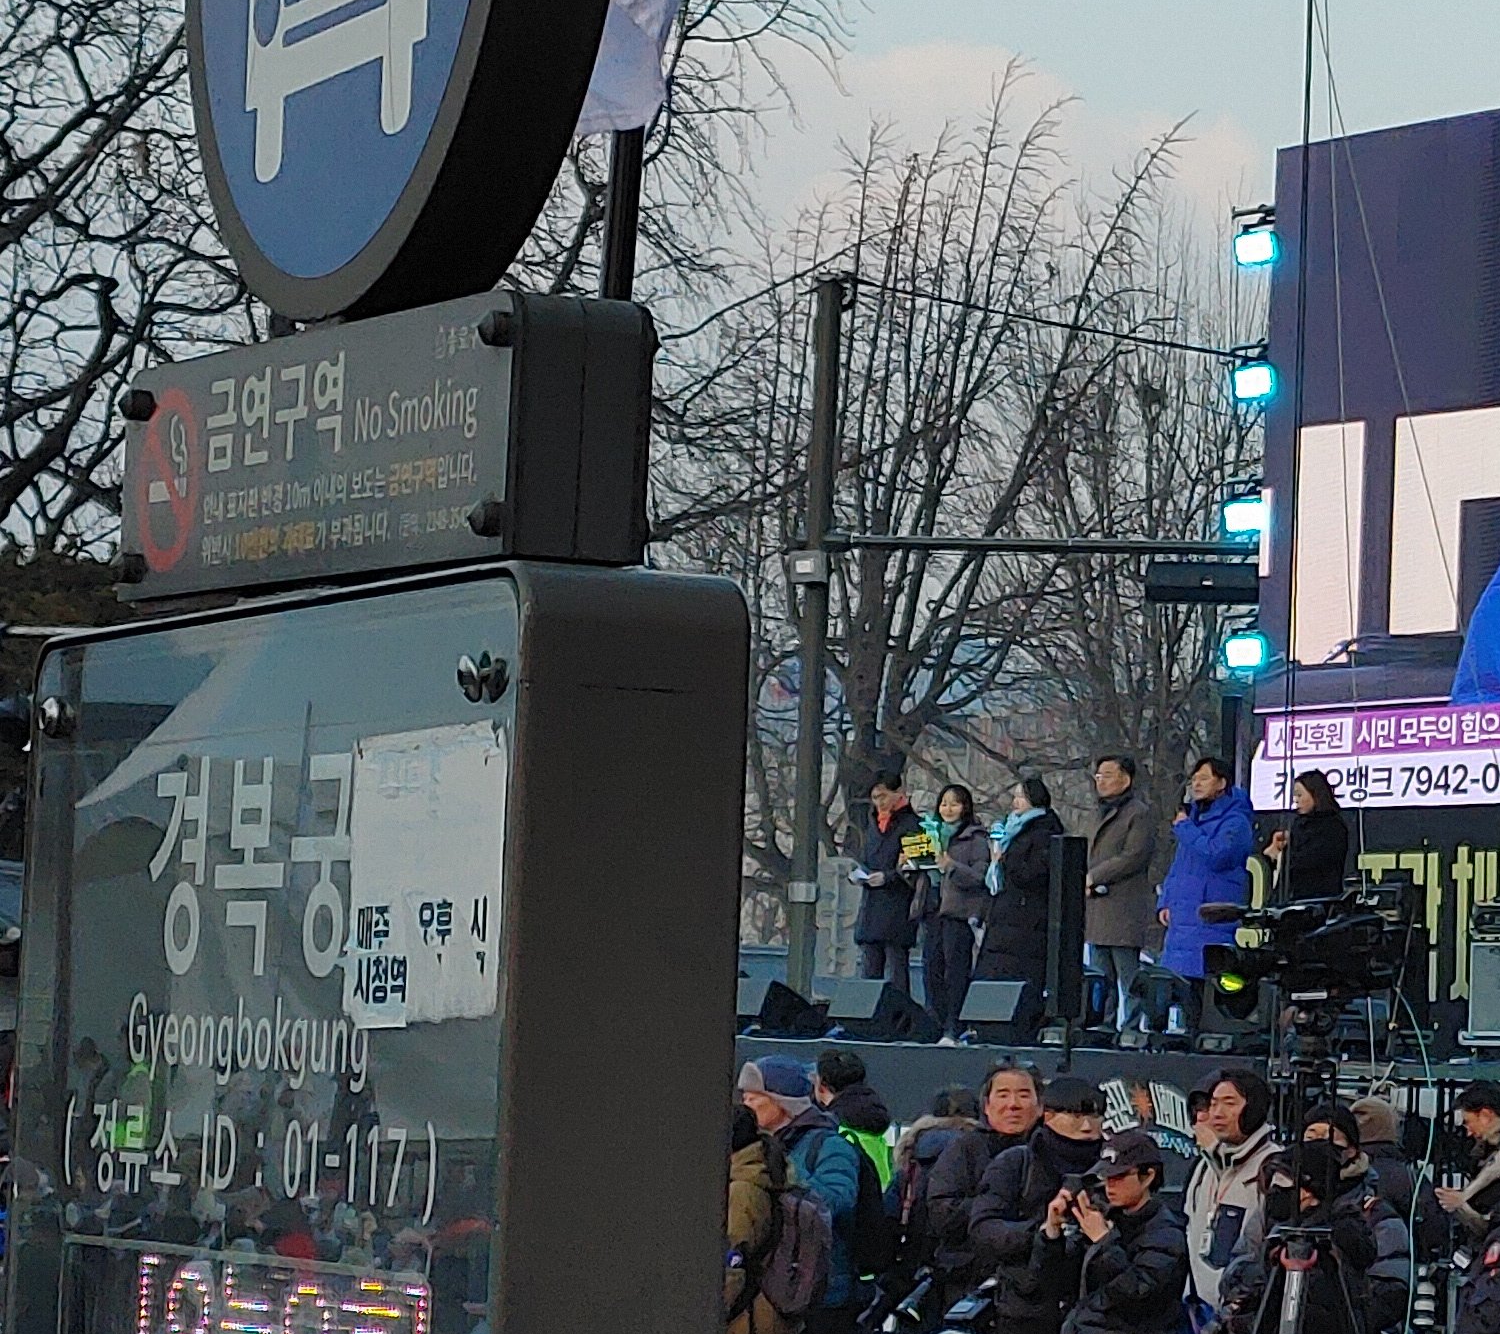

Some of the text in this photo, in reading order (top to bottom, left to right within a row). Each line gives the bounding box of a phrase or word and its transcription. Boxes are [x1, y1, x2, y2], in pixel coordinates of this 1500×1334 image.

[206, 350, 479, 473] 금연구역 No Smoking
[350, 467, 386, 499] 보도는
[1274, 721, 1344, 751] 시민후원
[1357, 717, 1396, 751] 시민
[1398, 712, 1458, 746] 모두의
[1273, 764, 1394, 803] 카오뱅크
[149, 753, 353, 978] 경복궁
[357, 904, 390, 949] 매주
[353, 955, 407, 1004] 시청역
[128, 992, 369, 1093] Gyeongbokgung
[201, 1114, 237, 1190] ID
